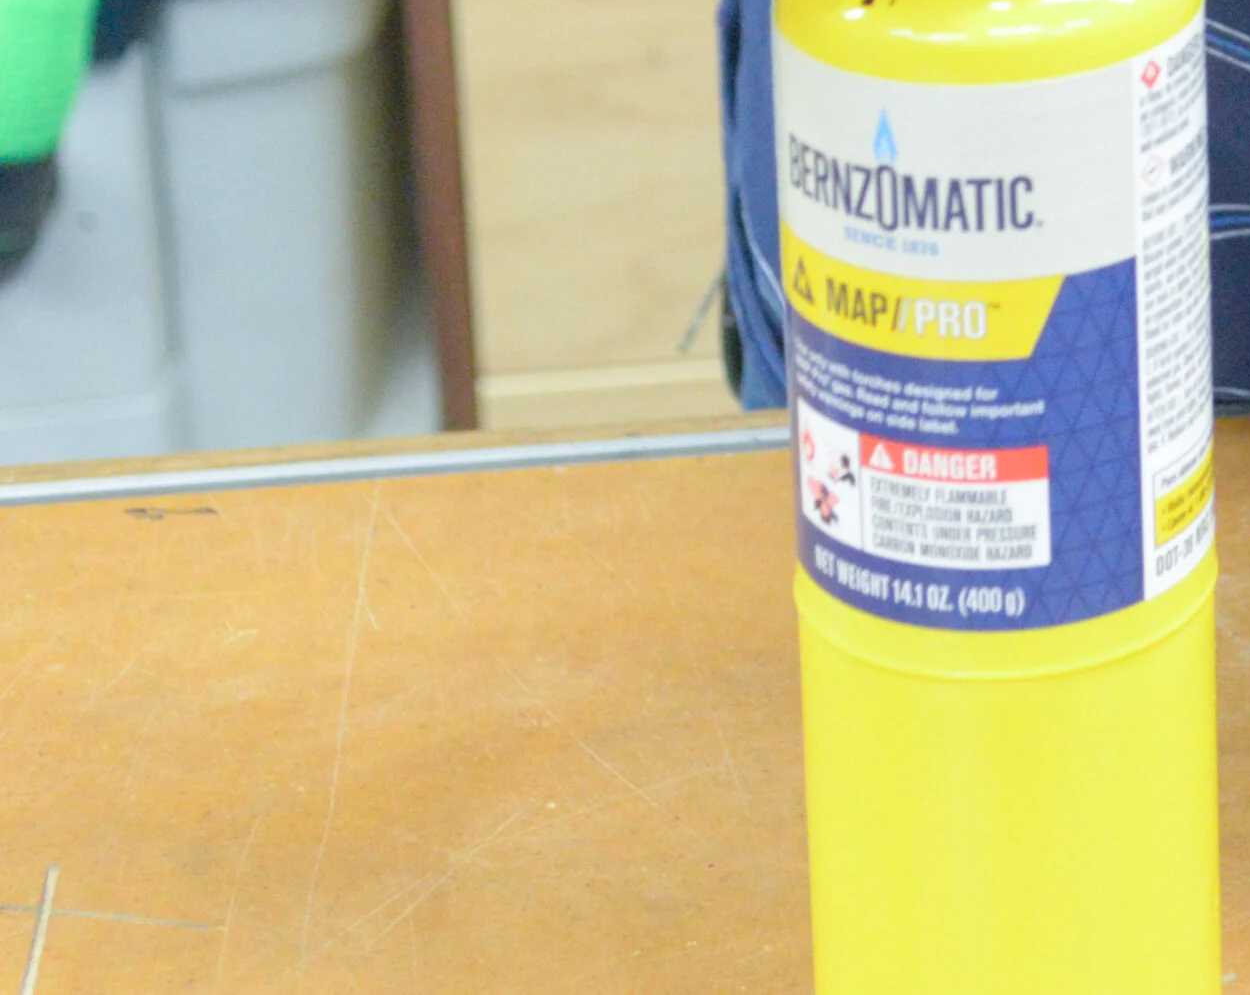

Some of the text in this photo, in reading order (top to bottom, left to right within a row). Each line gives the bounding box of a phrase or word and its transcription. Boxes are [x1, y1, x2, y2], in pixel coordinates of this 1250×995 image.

[788, 132, 1036, 233] BERNZOMATIC
[856, 386, 890, 409] Read
[891, 398, 919, 415] and
[920, 400, 968, 419] follow
[969, 398, 1046, 421] important
[902, 381, 973, 402] designed
[974, 384, 999, 402] for
[885, 413, 918, 430] side
[918, 416, 960, 435] label.
[902, 447, 998, 481] DANGER
[870, 476, 1008, 505] EXTREMELY FLAMMABLE
[871, 514, 1037, 542] CONTENTS UNDER PRESSURE
[965, 507, 1013, 523] HAZARD
[872, 532, 1034, 562] CARBON MONOXIDE HAZARD
[813, 543, 1026, 618] NET WEIGHT 14.1 OZ. (400 g)
